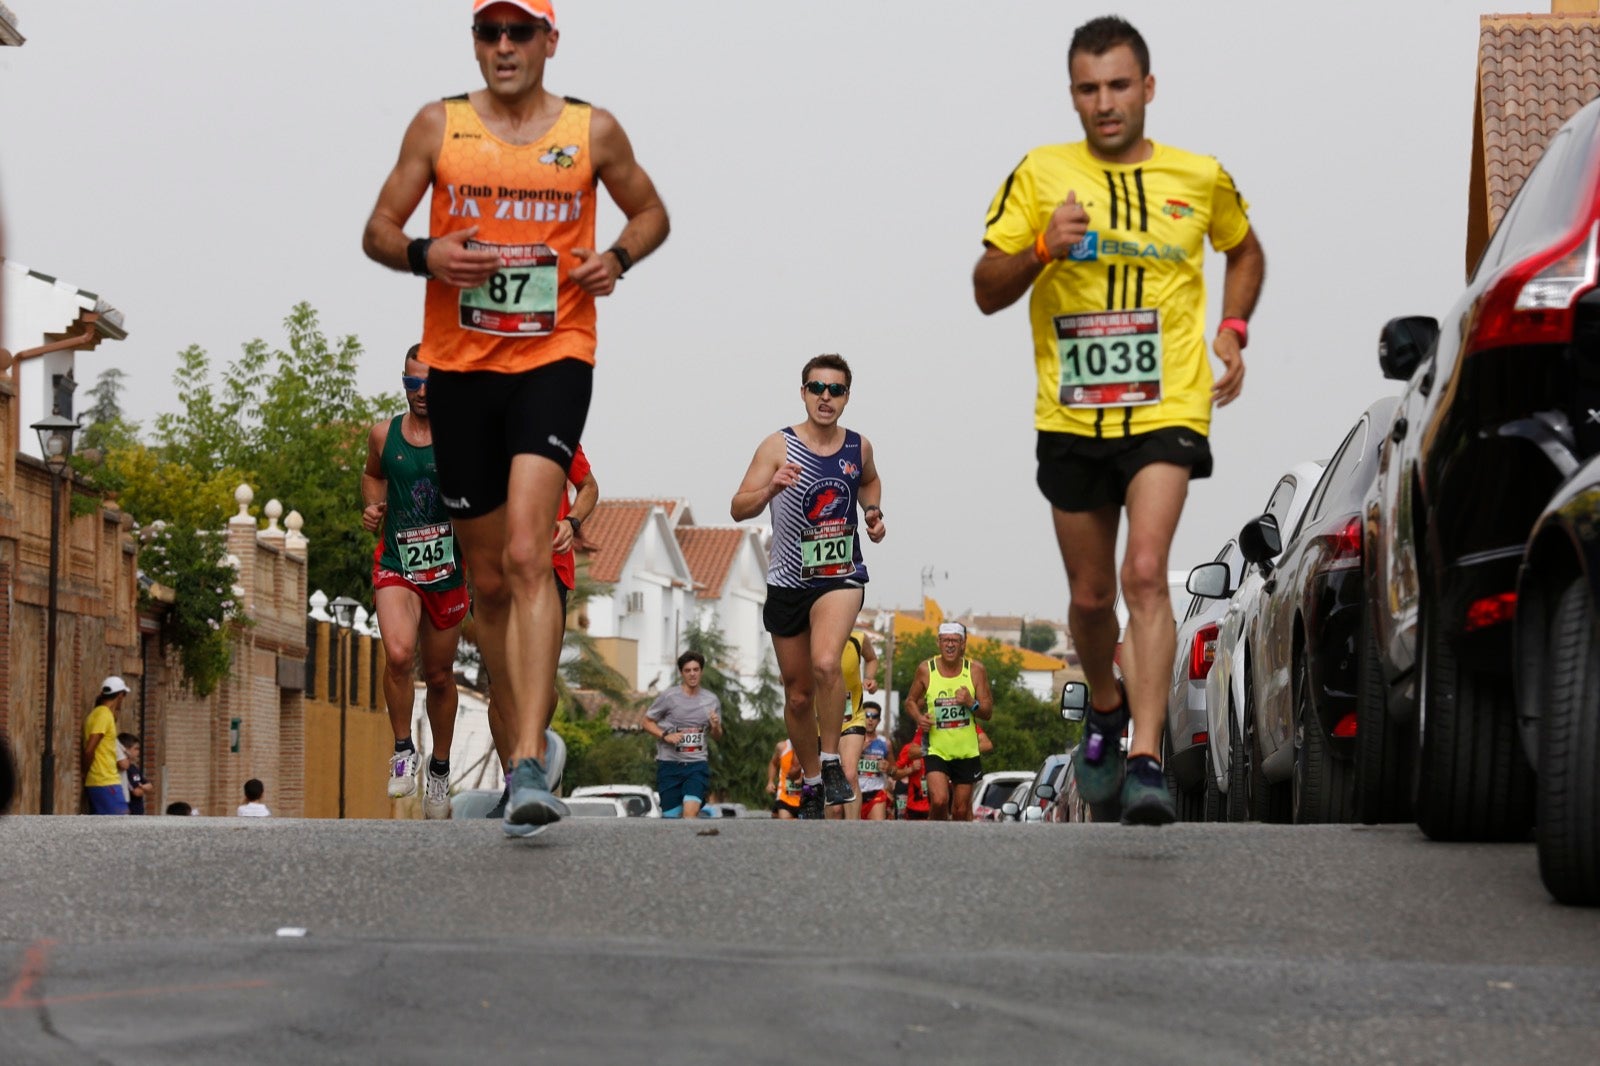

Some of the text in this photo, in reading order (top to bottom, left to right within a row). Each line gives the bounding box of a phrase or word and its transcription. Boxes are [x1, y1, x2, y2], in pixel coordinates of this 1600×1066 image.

[459, 184, 573, 202] Club Deportivo
[488, 272, 531, 305] 87
[1066, 340, 1157, 377] 1038
[407, 541, 445, 568] 245
[813, 539, 847, 562] 120
[941, 706, 966, 719] 264
[859, 760, 880, 771] 109
